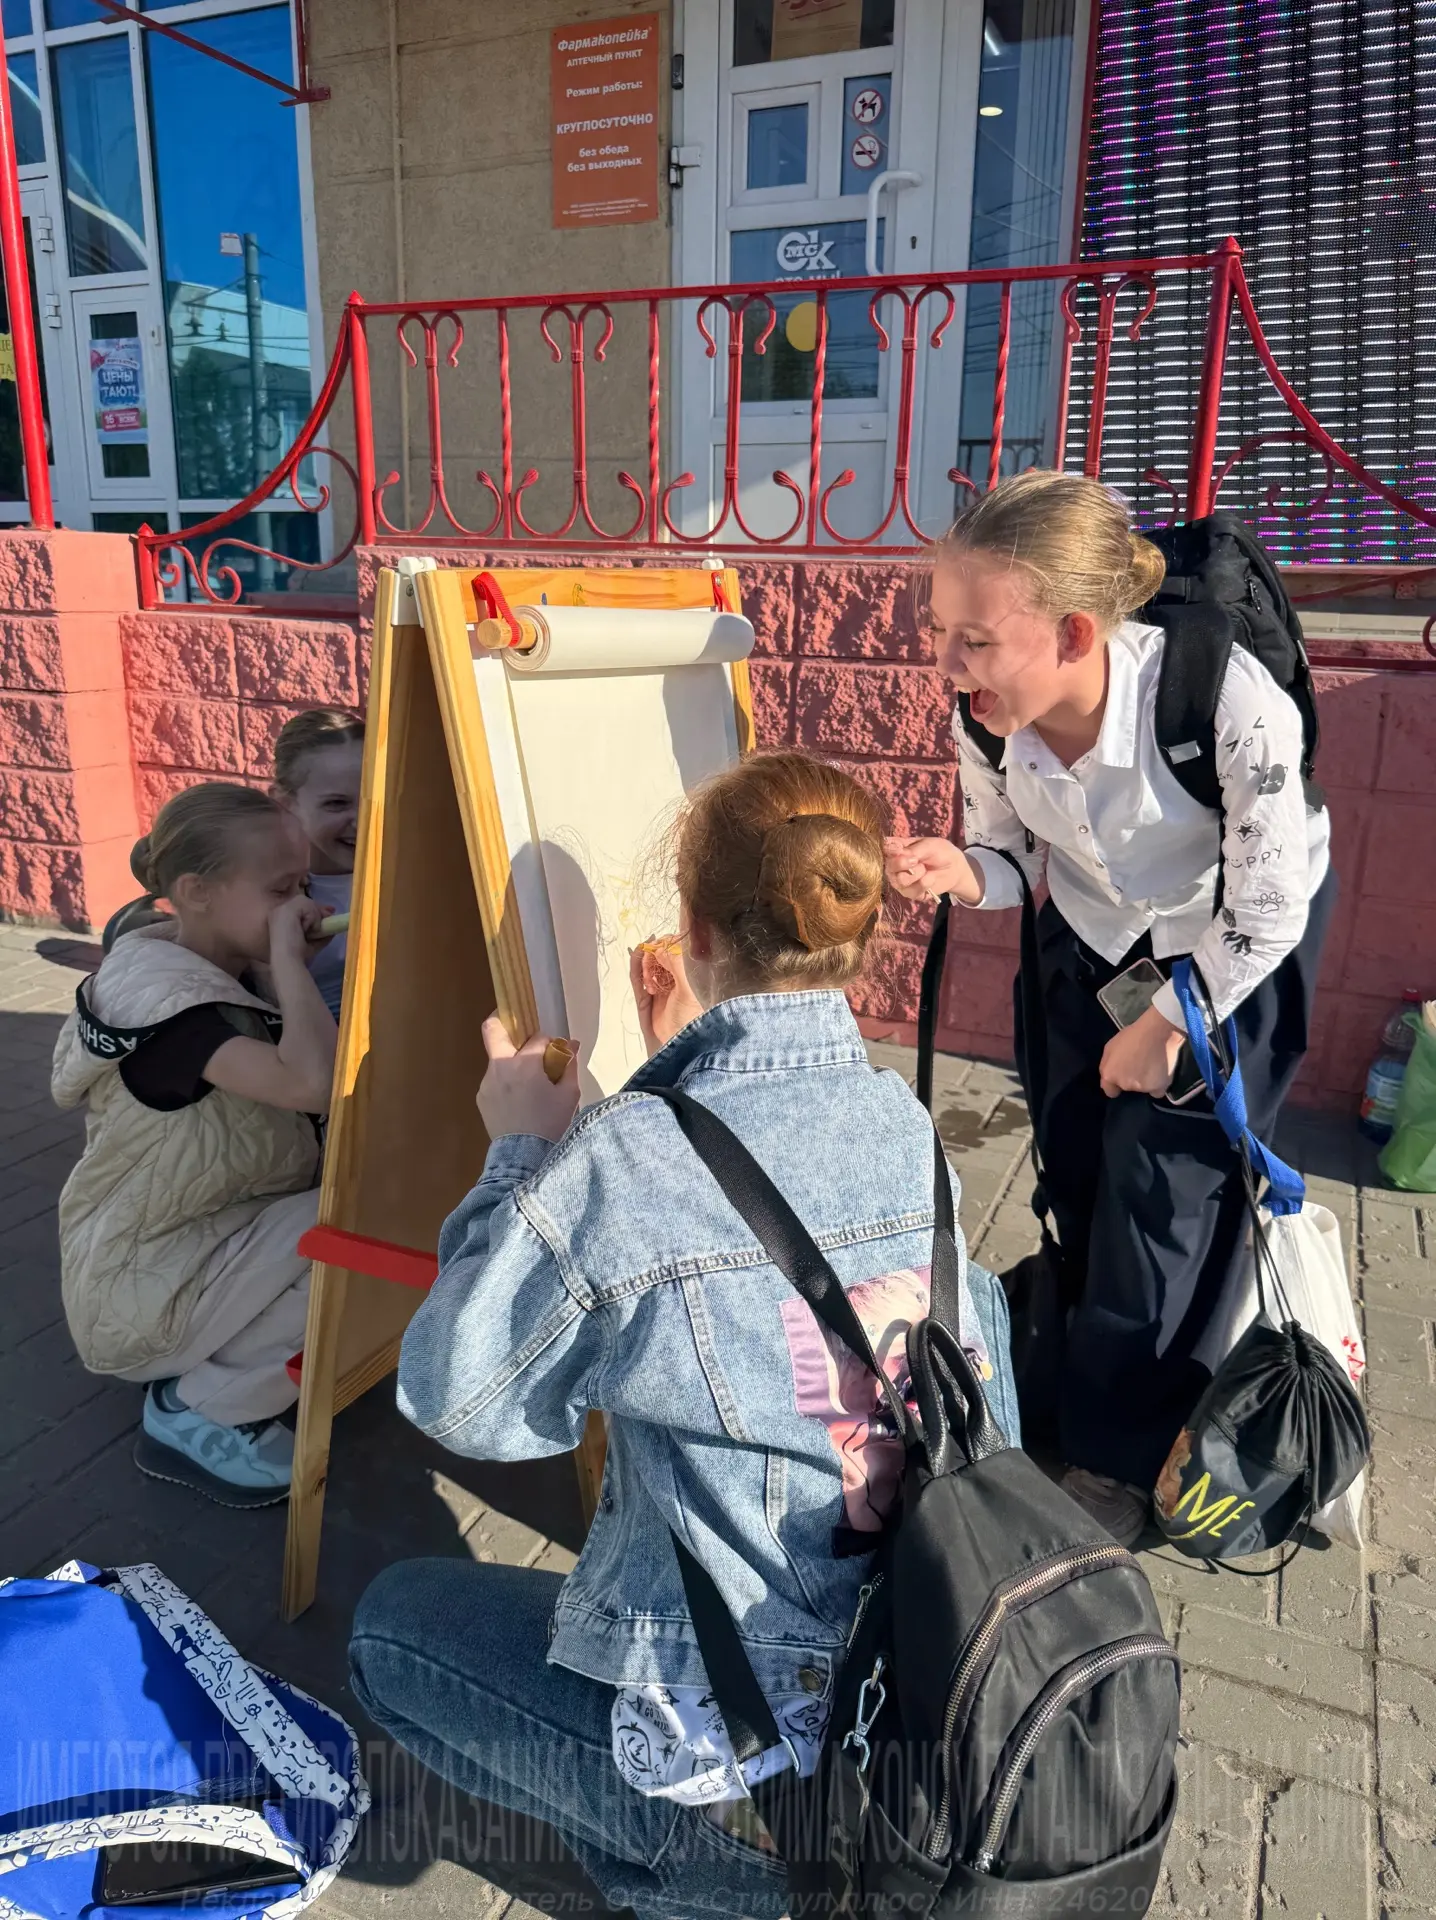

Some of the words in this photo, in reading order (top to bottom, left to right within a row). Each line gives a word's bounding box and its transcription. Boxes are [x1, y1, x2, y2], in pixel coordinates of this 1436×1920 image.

[557, 28, 649, 52] Фармакопейка
[566, 52, 613, 68] АПТЕЧНЫЙ
[614, 49, 643, 61] ПУНКТ
[566, 85, 601, 98] Режим
[602, 80, 643, 96] работы:
[556, 113, 654, 135] КРУГЛОСУТОЧНО
[579, 147, 597, 158] без
[599, 145, 630, 157] обеда
[567, 162, 586, 173] без
[588, 157, 643, 171] выходных
[102, 370, 134, 385] ЦЕНЫ
